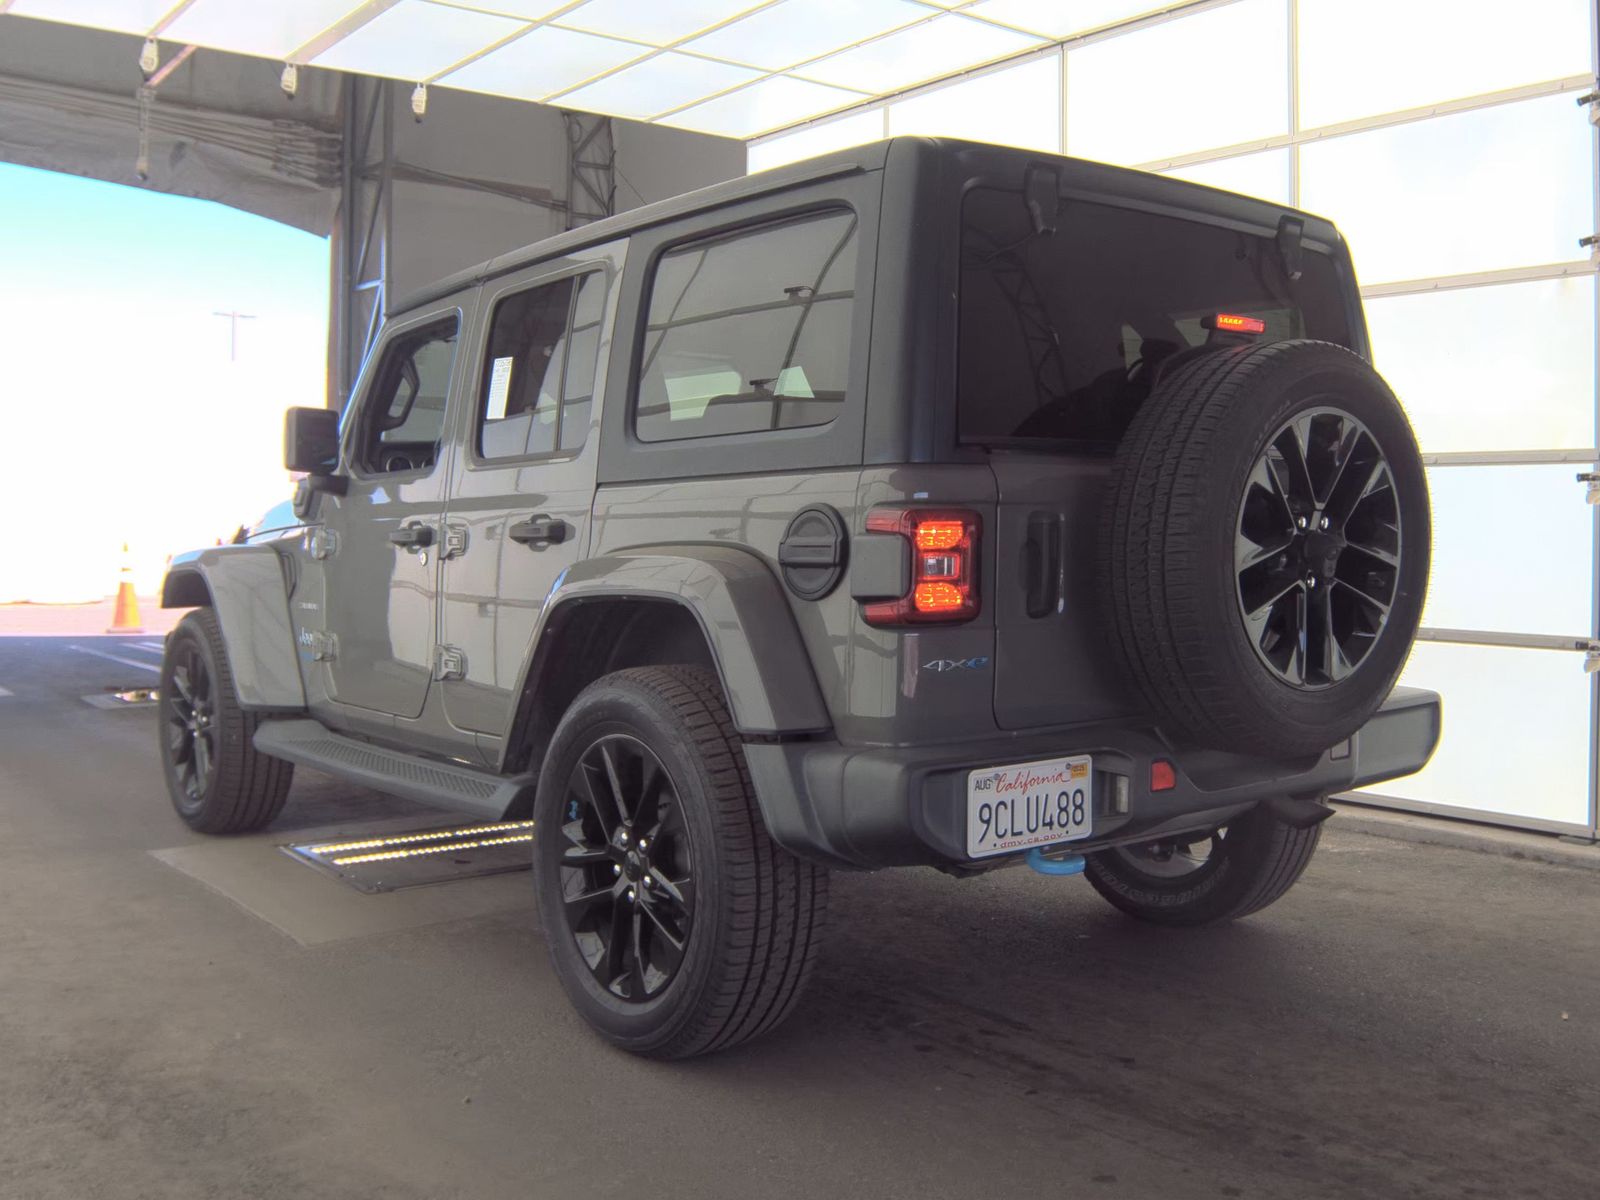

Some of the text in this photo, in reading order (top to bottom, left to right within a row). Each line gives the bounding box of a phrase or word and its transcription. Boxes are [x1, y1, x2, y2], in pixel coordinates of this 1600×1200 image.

[974, 778, 991, 791] AUG
[995, 769, 1072, 794] California
[978, 788, 1085, 844] 9CLU488
[1000, 833, 1064, 849] dmv.ca.gov
